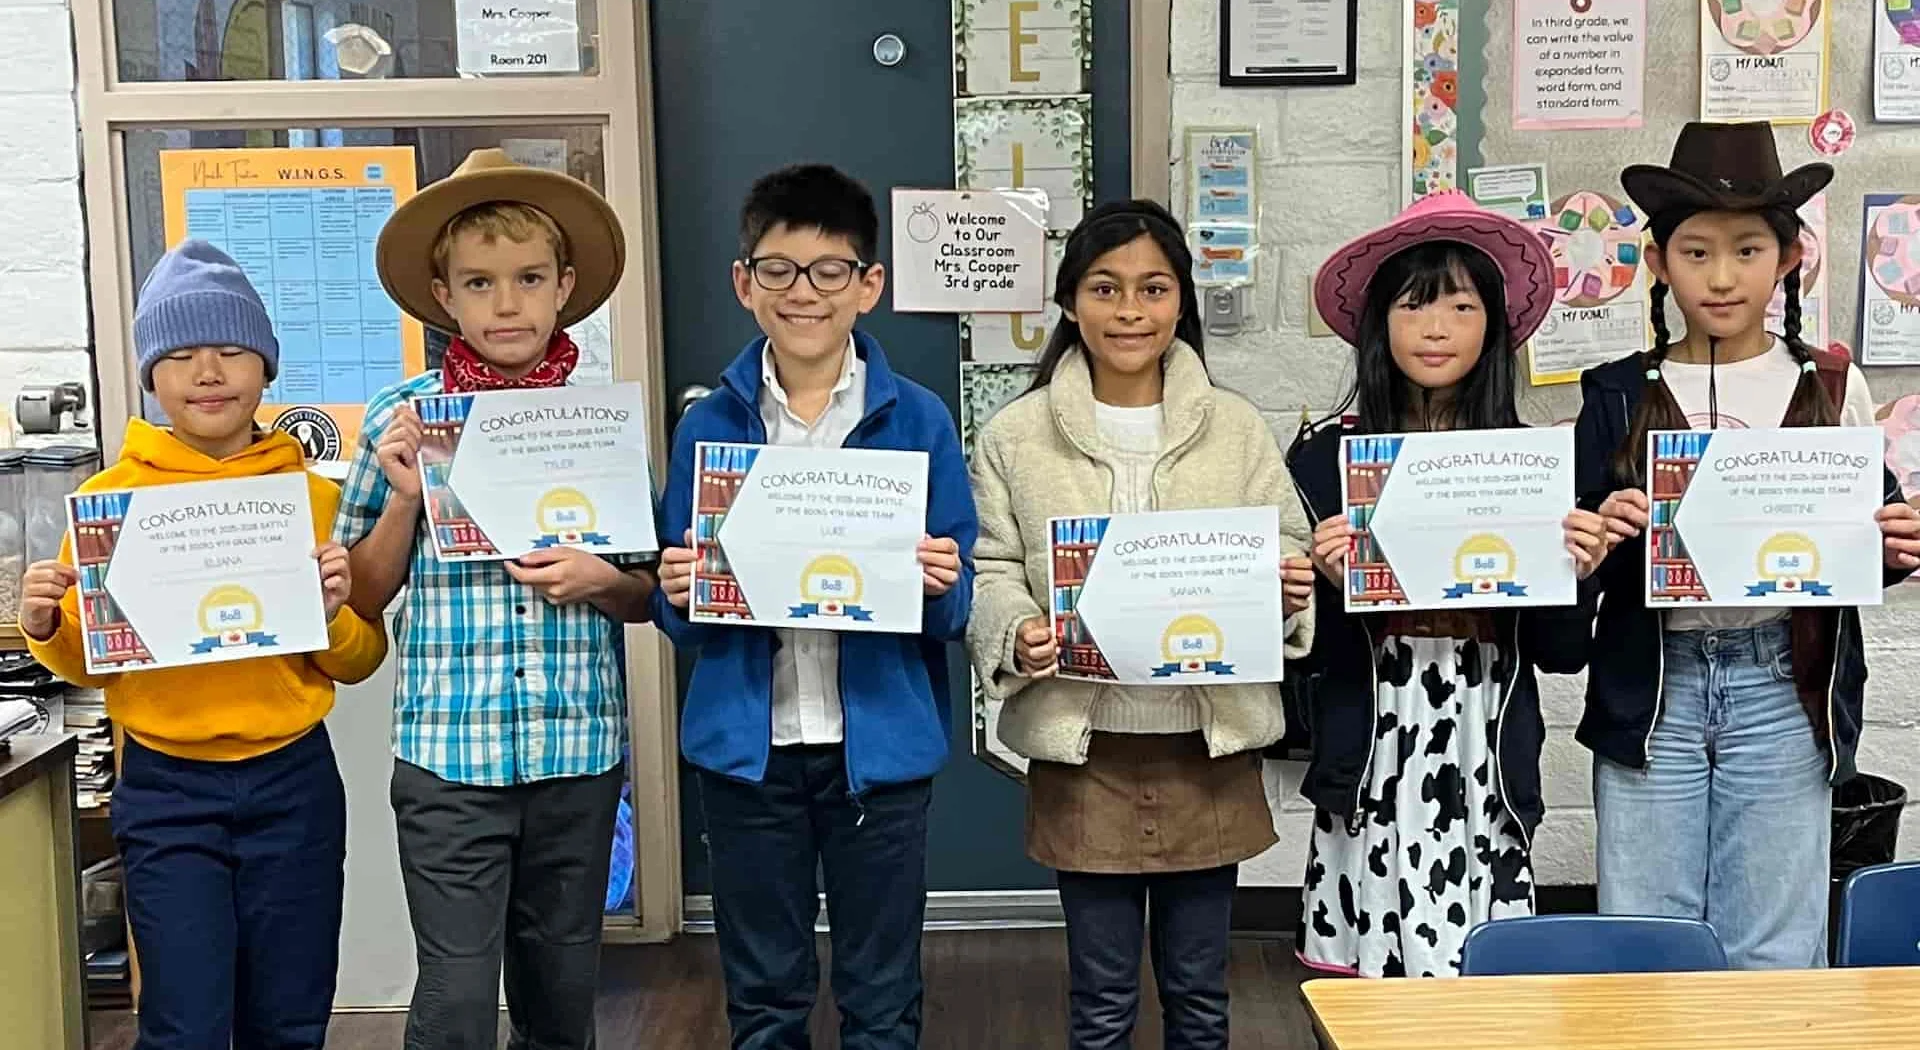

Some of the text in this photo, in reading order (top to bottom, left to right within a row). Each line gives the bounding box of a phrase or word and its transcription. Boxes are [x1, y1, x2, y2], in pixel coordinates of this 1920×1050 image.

[482, 8, 551, 21] Mrs. Cooper
[1532, 18, 1542, 27] In
[1546, 16, 1572, 27] third
[1574, 16, 1610, 28] grade,
[1526, 31, 1633, 44] can write the value
[491, 54, 547, 65] Room 201
[1539, 48, 1620, 60] of a number in
[1535, 65, 1592, 78] expanded
[1536, 82, 1565, 92] word
[1600, 80, 1622, 90] and
[1536, 97, 1589, 109] standard
[278, 168, 347, 180] W.I.N.G.S.
[946, 212, 1006, 225] Welcome
[955, 228, 1001, 241] to Our
[940, 244, 1015, 257] Classroom
[934, 259, 1021, 276] Mrs. Cooper
[944, 275, 1014, 292] 3rd grade
[480, 407, 629, 433] CONGRATULATIONS!
[1408, 452, 1559, 476] CONGRATULATIONS!
[1714, 450, 1868, 472] CONGRATULATIONS!
[760, 471, 912, 495] CONGRATULATIONS!
[139, 501, 296, 531] CONGRATULATIONS!
[1113, 532, 1264, 556] CONGRATULATIONS!
